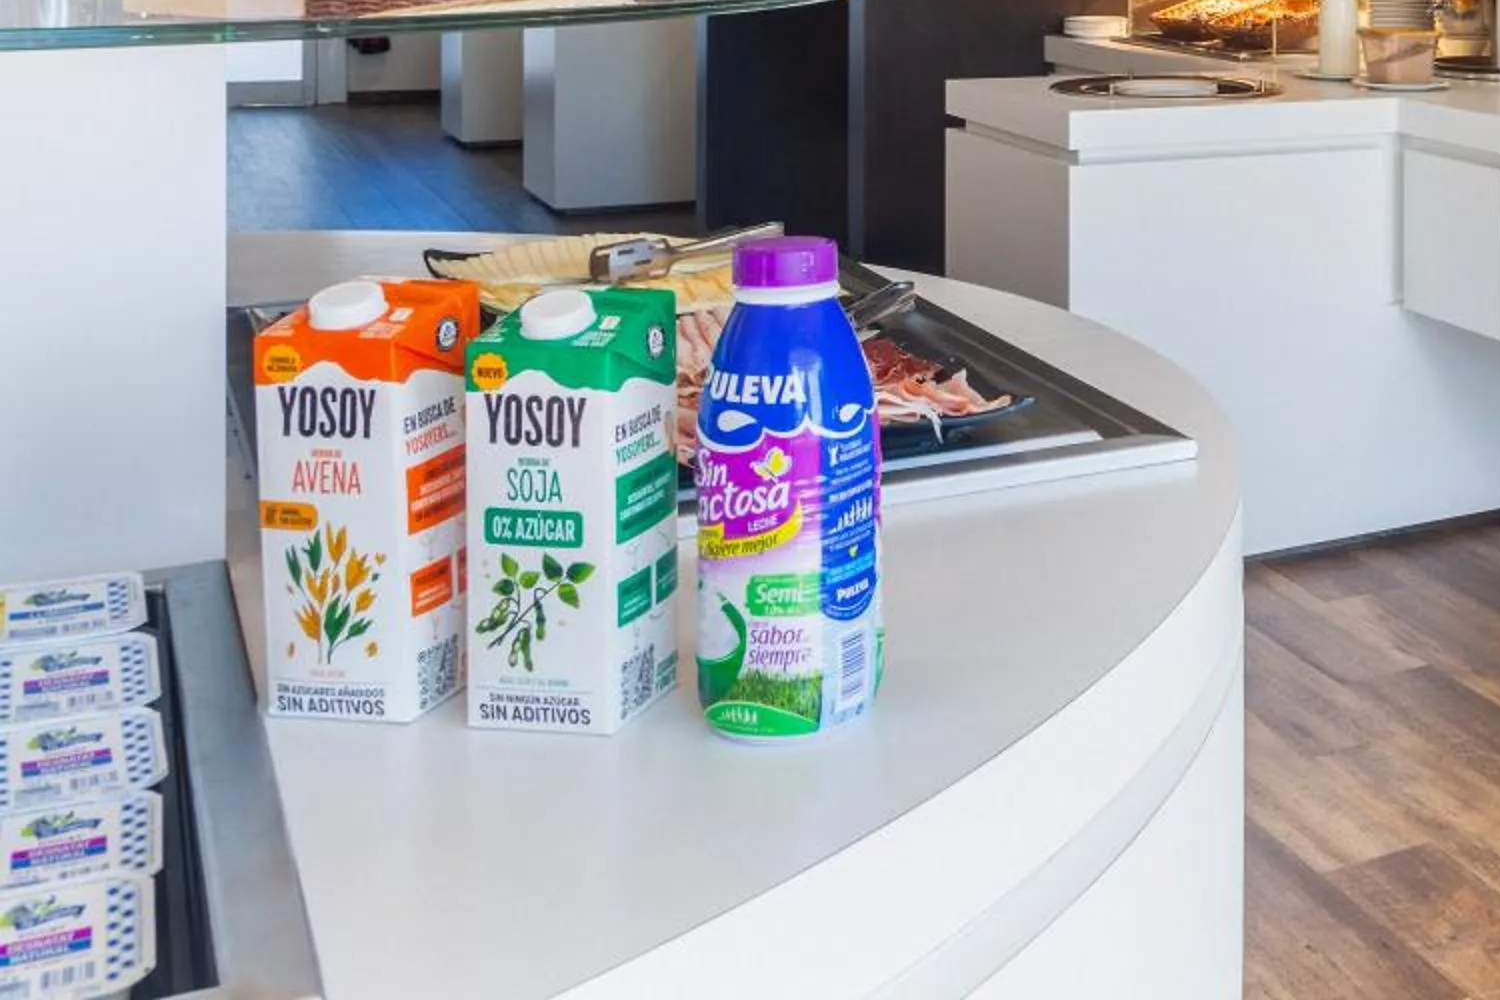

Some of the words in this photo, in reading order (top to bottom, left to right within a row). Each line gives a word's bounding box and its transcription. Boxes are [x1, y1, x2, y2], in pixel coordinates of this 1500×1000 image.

[477, 366, 504, 379] NUEVO
[277, 385, 376, 440] YOSOY
[484, 393, 587, 448] YOSOY
[291, 459, 362, 495] AVENA
[506, 467, 563, 503] SOJA
[695, 449, 727, 487] Sin
[696, 481, 790, 523] actosa
[492, 515, 513, 541] 0%
[515, 511, 576, 543] AZÚCAR
[749, 625, 804, 644] sabor
[277, 696, 303, 714] SIN
[308, 698, 386, 718] ADITIVOS
[479, 704, 508, 723] SIN
[512, 705, 592, 727] ADITIVOS
